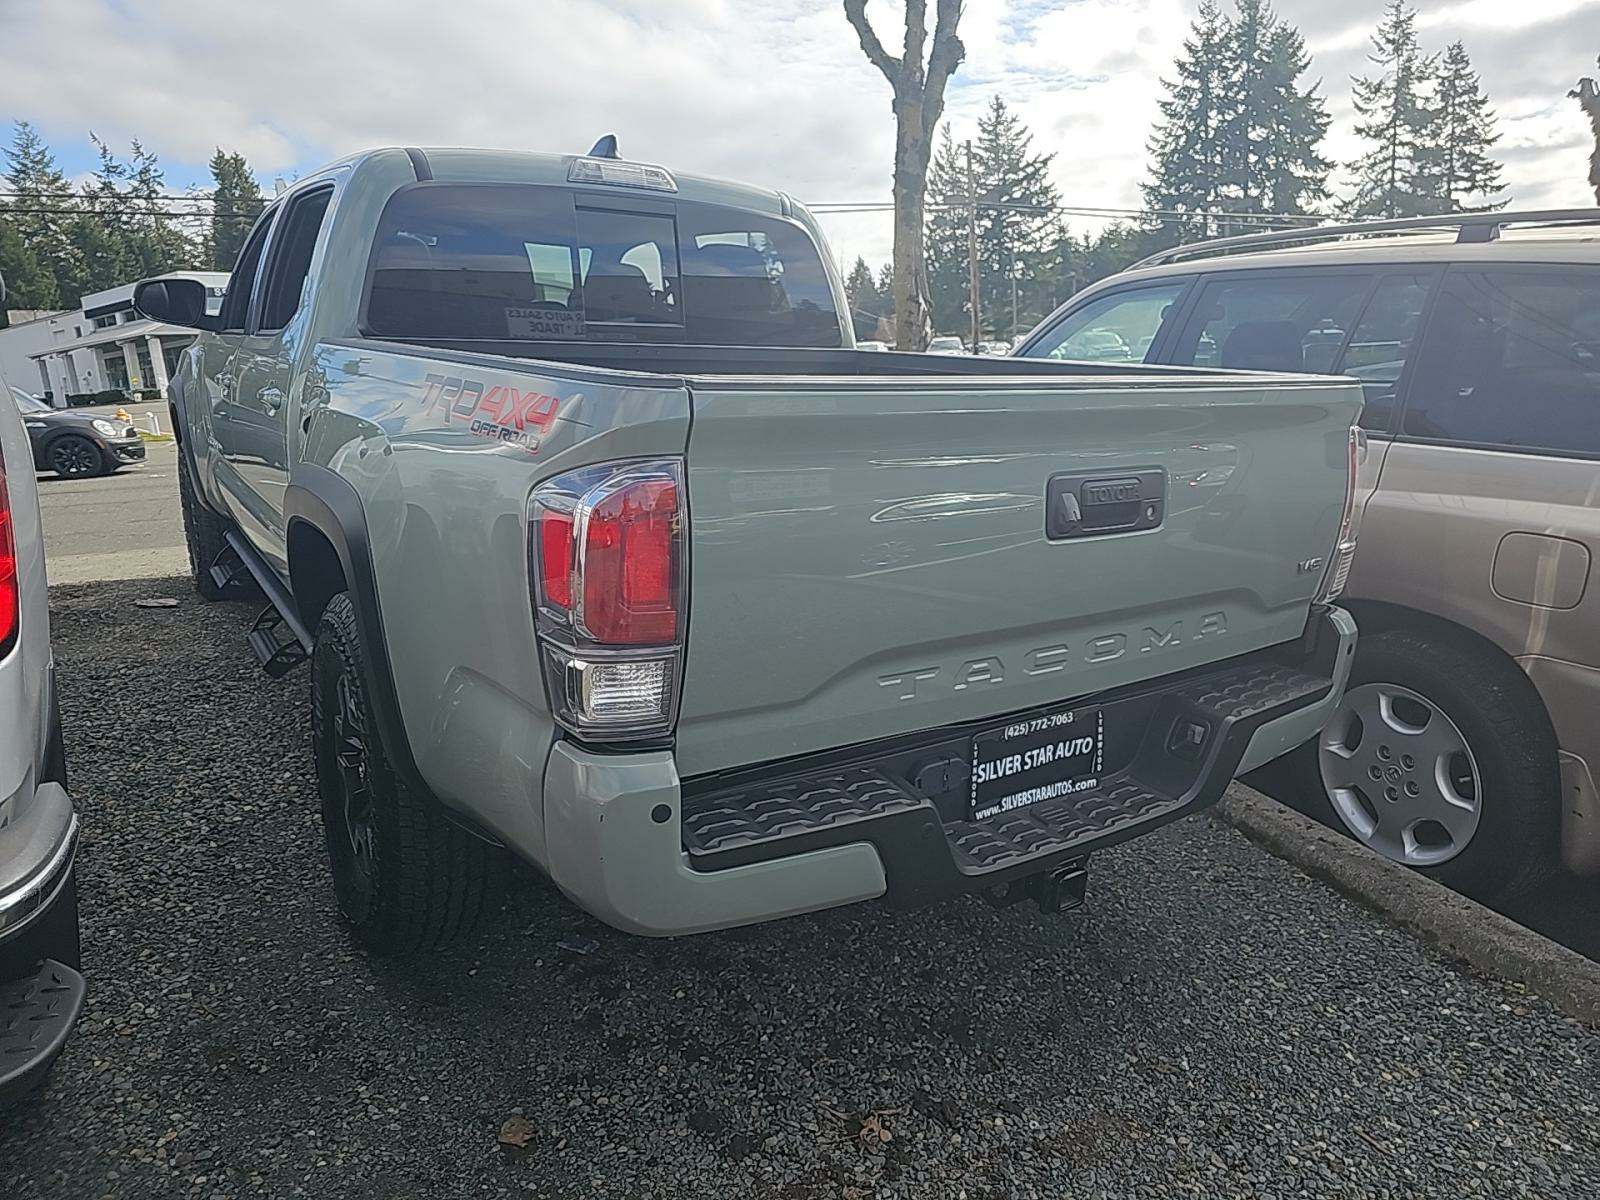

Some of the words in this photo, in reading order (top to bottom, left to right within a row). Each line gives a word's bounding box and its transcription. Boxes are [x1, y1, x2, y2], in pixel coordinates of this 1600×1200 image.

[479, 385, 560, 433] 4X4
[878, 610, 1229, 700] TACOMA
[1004, 724, 1029, 740] (425)
[1030, 712, 1074, 731] 772-7063
[977, 754, 1022, 783] SILVER
[1023, 744, 1054, 770] STAR
[1054, 736, 1093, 760] AUTO
[975, 778, 1097, 820] www.SILVERSTARAUTOS.com
